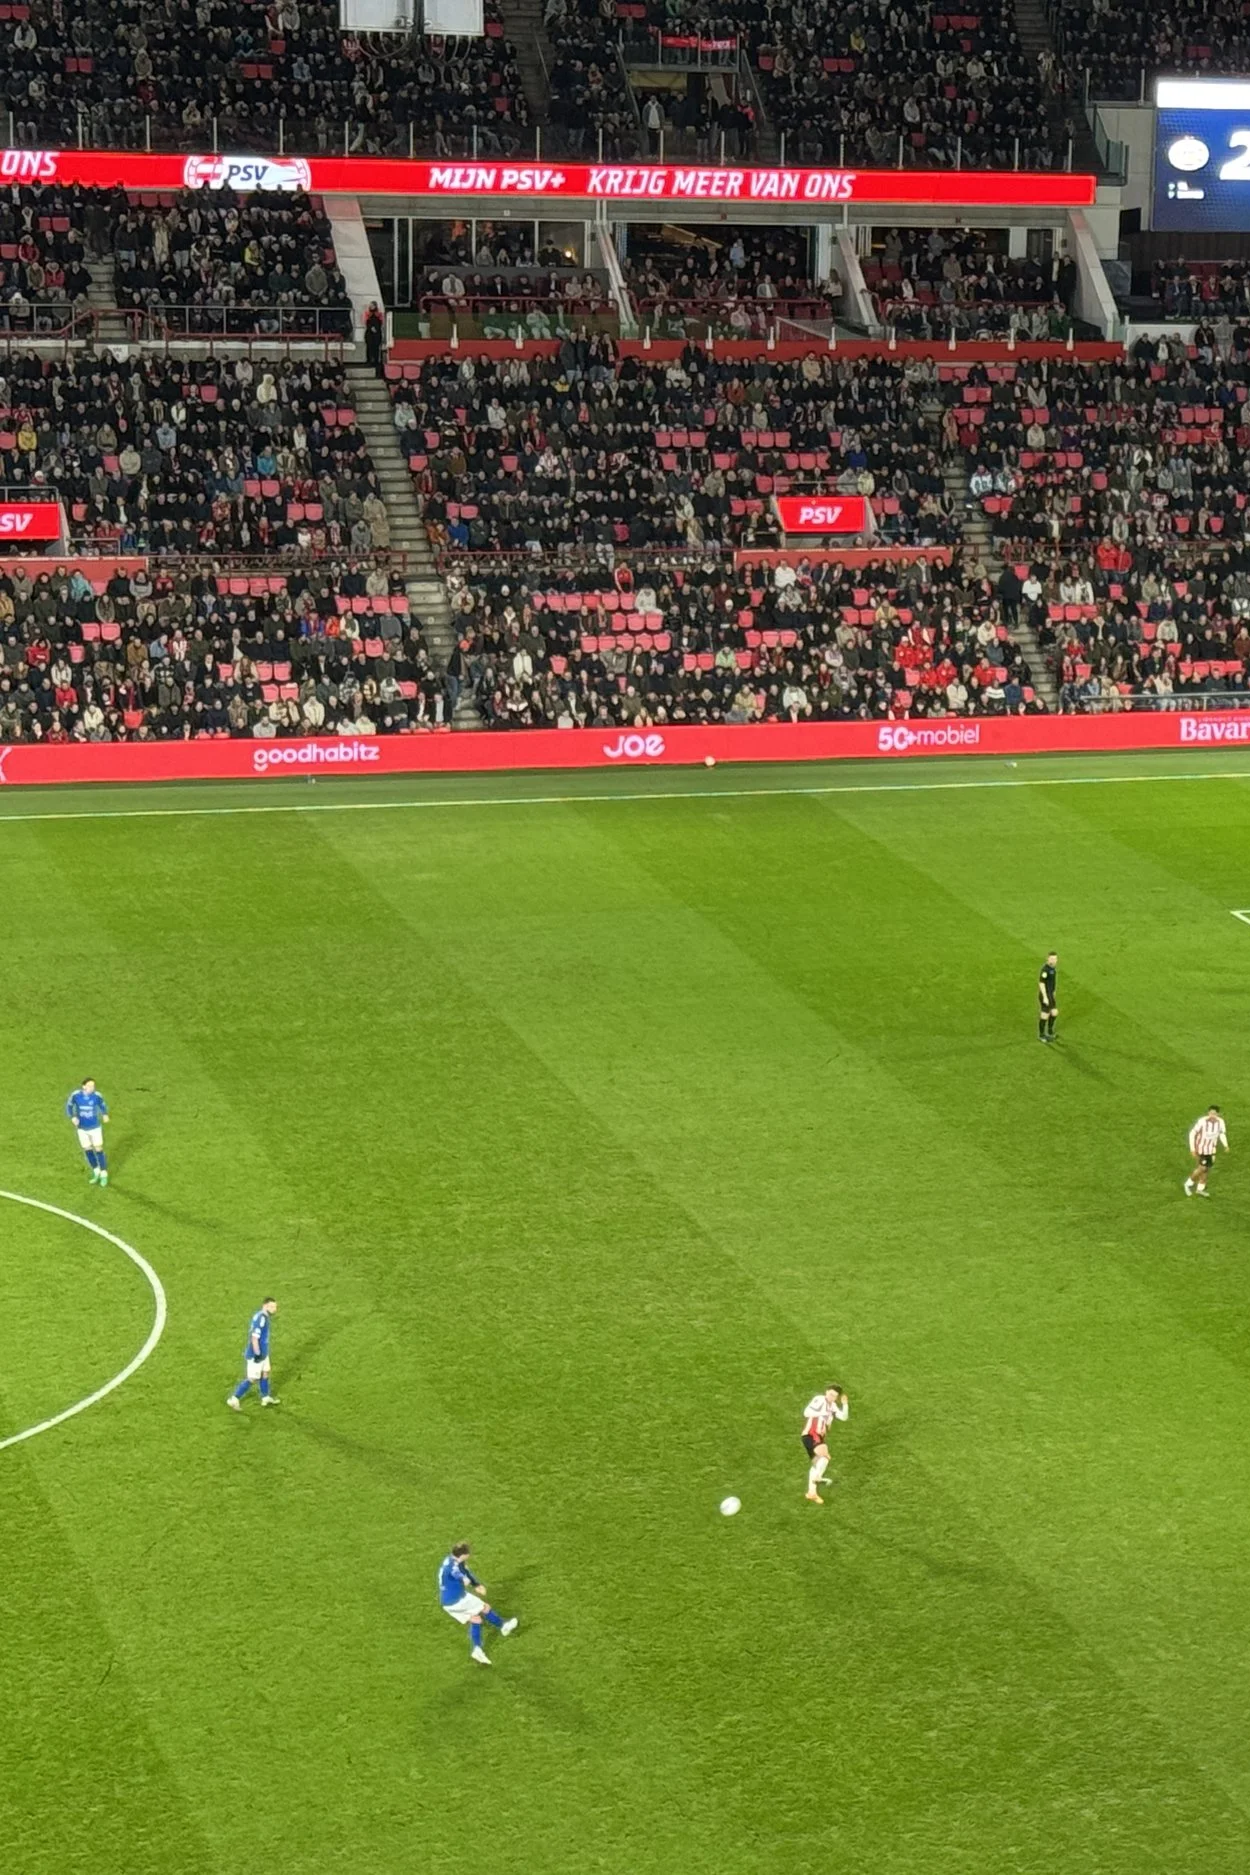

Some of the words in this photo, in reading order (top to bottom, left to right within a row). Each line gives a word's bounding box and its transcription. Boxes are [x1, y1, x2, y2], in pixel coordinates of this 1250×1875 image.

[1, 151, 58, 176] ONS
[228, 164, 269, 181] PSV
[429, 168, 492, 189] MIJN
[500, 169, 565, 190] PSV+
[587, 168, 667, 194] KRIJG
[672, 170, 741, 197] MEER
[749, 172, 800, 197] VAN
[804, 173, 855, 198] ONS
[0, 512, 34, 533] SV
[799, 505, 843, 525] PSV
[253, 741, 380, 772] goodhabitz
